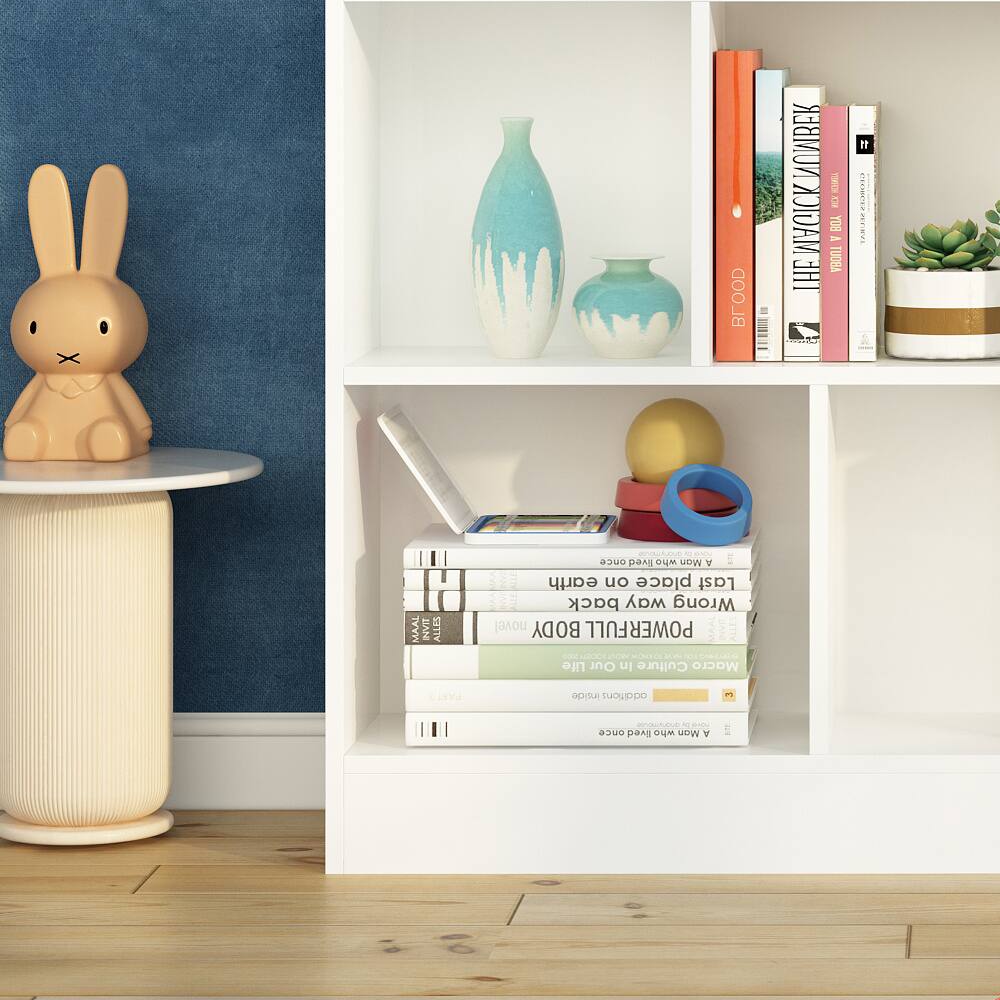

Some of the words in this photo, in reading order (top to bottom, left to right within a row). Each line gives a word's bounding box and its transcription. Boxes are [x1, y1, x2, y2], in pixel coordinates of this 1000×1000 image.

[600, 558, 626, 566] once
[628, 558, 653, 568] lived
[655, 558, 677, 568] who
[680, 558, 702, 568] Man
[704, 558, 712, 568] A
[548, 576, 598, 590] earth
[603, 576, 629, 588] on
[633, 573, 691, 590] place
[698, 576, 734, 590] Last
[568, 597, 619, 611] back
[626, 593, 666, 608] way
[674, 594, 734, 611] Wrong
[412, 616, 420, 643] MAAL
[422, 618, 430, 640] INVIT
[433, 616, 441, 642] ALLES
[494, 620, 528, 633] novel
[532, 620, 580, 638] BODY
[585, 620, 693, 638] POWERFULL
[561, 661, 580, 672] Life
[583, 661, 615, 672] Our
[618, 661, 632, 672] In
[637, 661, 688, 672] Culture
[691, 661, 738, 672] Macro
[572, 691, 601, 702] inside
[603, 691, 647, 702] additions
[599, 729, 624, 737] once
[627, 729, 651, 739] lived
[653, 729, 675, 739] who
[678, 729, 699, 739] Man
[703, 729, 710, 739] A
